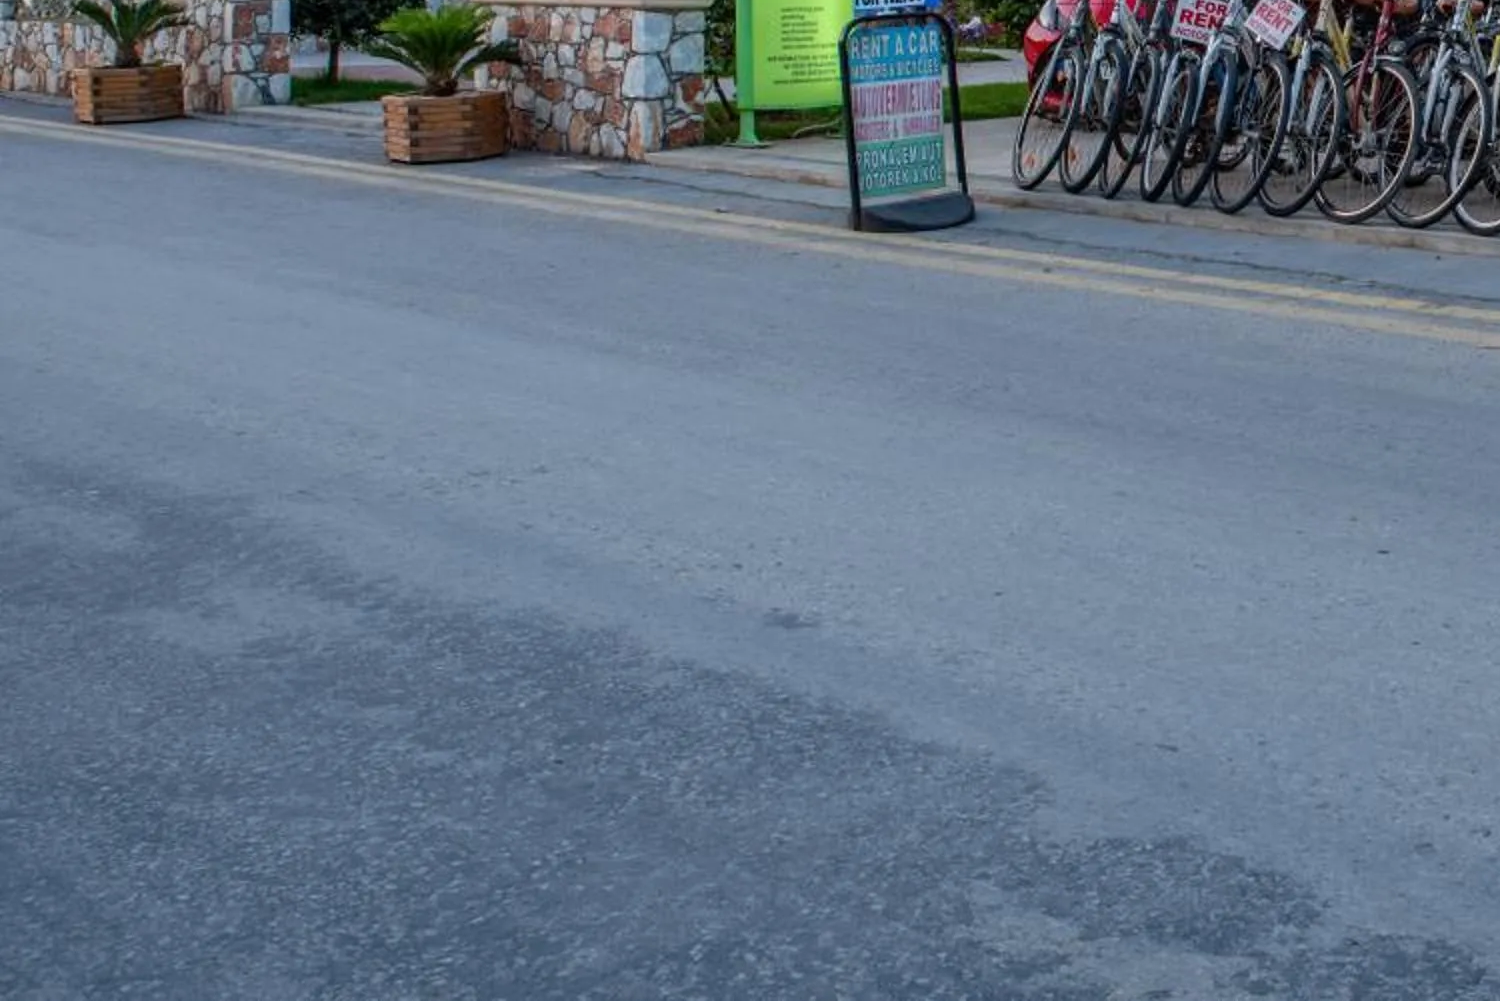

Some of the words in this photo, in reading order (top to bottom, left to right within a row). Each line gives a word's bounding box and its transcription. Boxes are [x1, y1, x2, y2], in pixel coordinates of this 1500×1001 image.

[1179, 8, 1224, 30] REN
[1256, 3, 1294, 33] RENT
[851, 34, 890, 59] RENT
[895, 33, 905, 56] A
[908, 30, 939, 54] CAR
